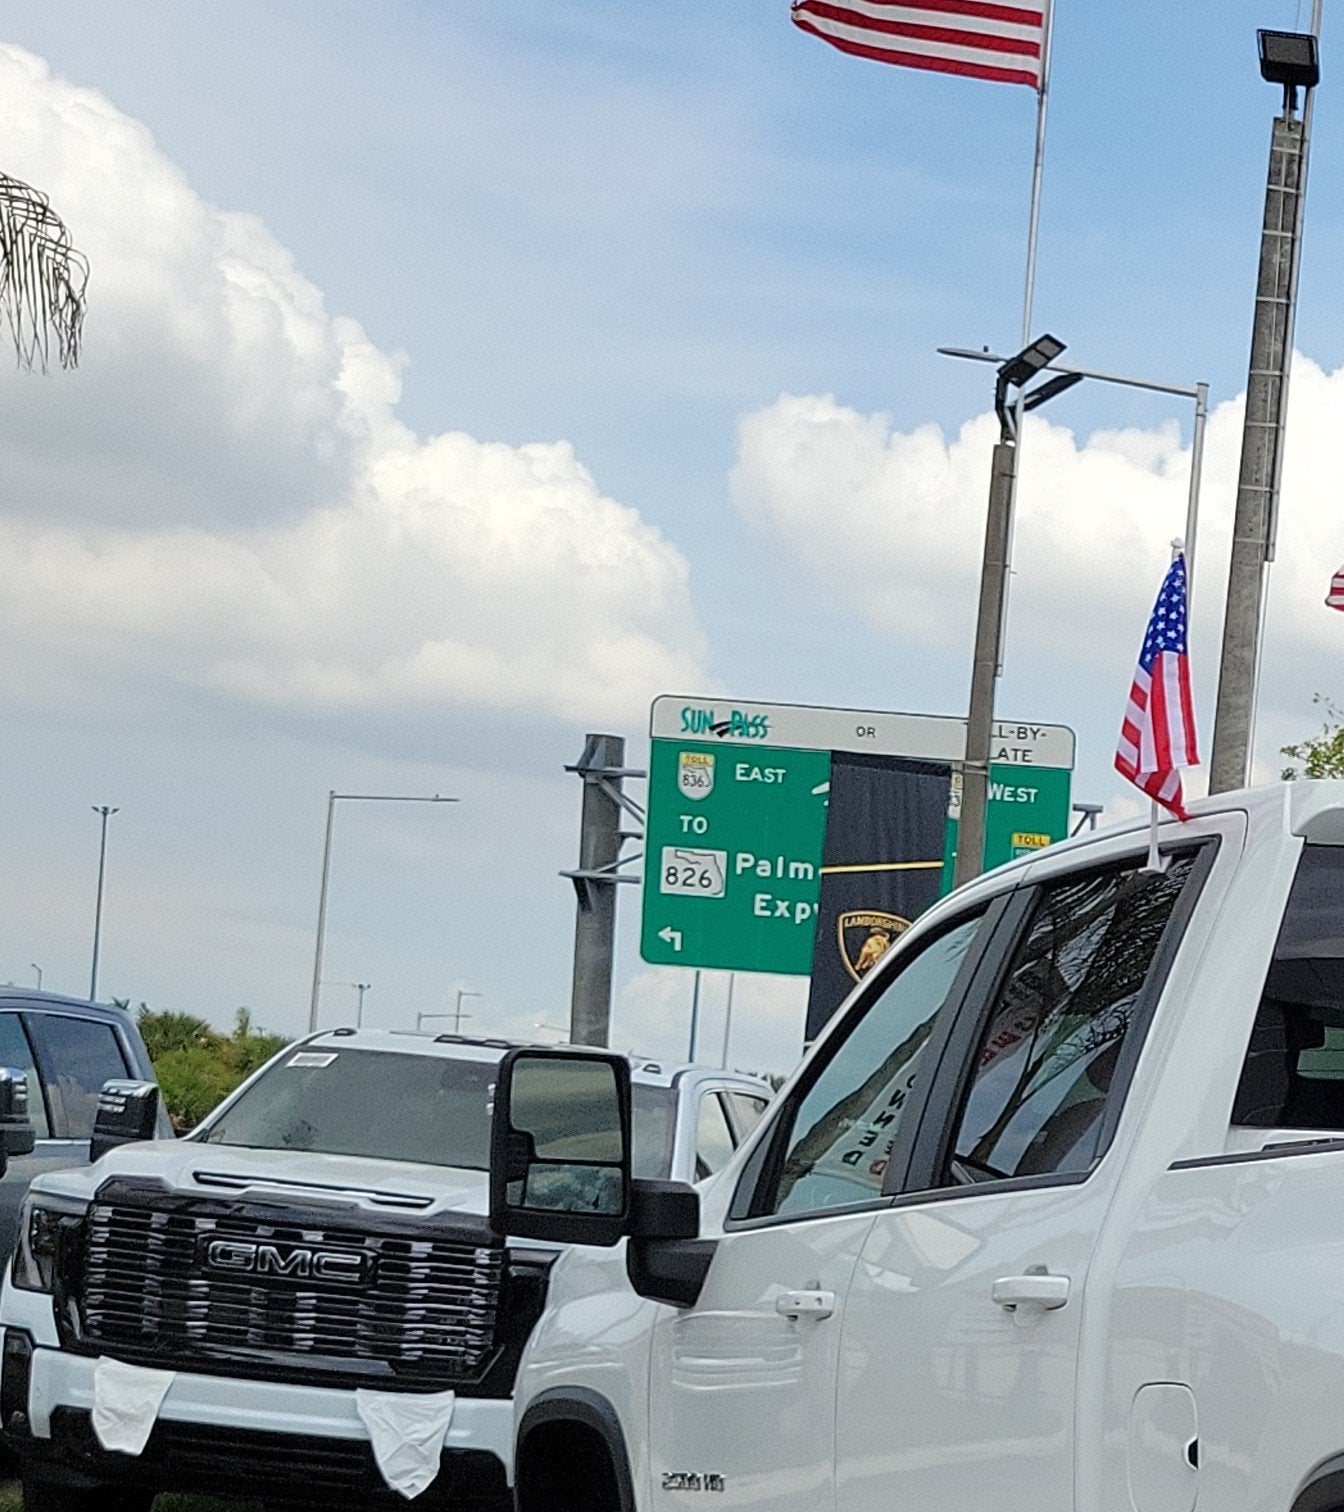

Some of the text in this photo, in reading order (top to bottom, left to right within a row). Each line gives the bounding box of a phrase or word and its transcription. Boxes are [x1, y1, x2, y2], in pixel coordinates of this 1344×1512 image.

[856, 726, 876, 738] OR
[990, 725, 1047, 741] L-BY-
[685, 754, 710, 766] TOLL
[989, 747, 1033, 763] ATE
[682, 773, 705, 789] 836
[735, 763, 787, 784] EAST
[988, 782, 1038, 803] WEST
[680, 815, 708, 834] TO
[1017, 833, 1046, 847] TOLL
[735, 852, 814, 880] Palm
[665, 866, 712, 888] 826
[754, 893, 820, 924] Exp
[208, 1240, 362, 1282] GMC
